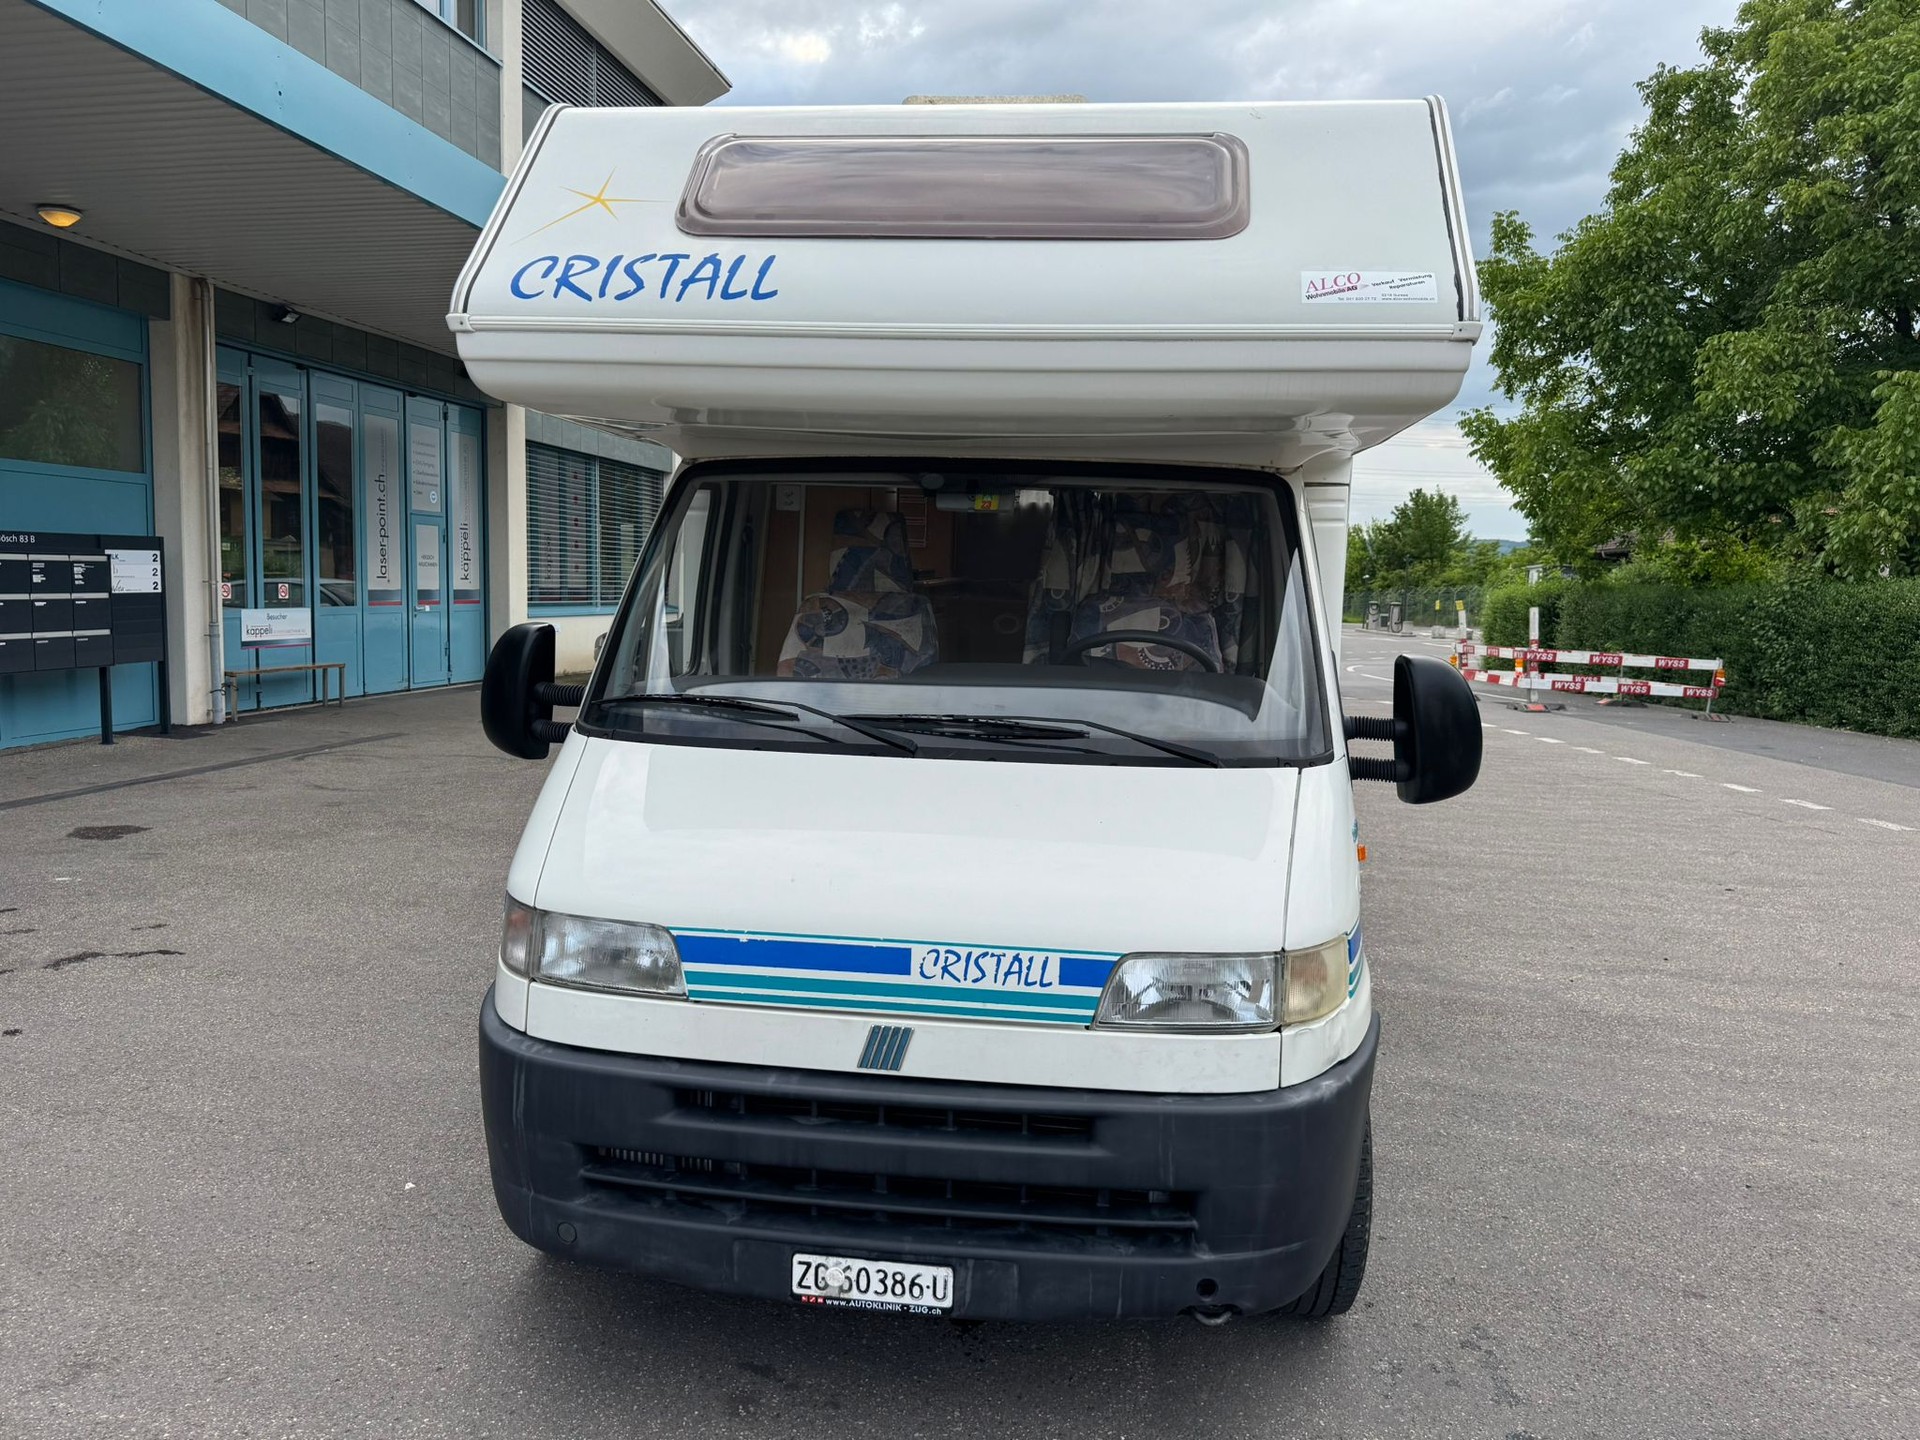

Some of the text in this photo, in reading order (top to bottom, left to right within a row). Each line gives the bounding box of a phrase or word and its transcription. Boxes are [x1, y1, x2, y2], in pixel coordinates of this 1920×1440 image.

[510, 253, 778, 302] CRISTALL
[1305, 272, 1361, 293] ALCO
[375, 474, 389, 579] laser-point.ch
[0, 534, 36, 543] ösch 83 B
[459, 522, 472, 581] kappeli
[152, 553, 159, 562] 2
[152, 567, 159, 577] 2
[152, 581, 159, 591] 2
[246, 624, 273, 638] kappeli
[1526, 652, 1554, 661] WYSS
[1592, 656, 1619, 665] WYSS
[1658, 659, 1685, 668] WYSS
[1554, 681, 1581, 690] WYSS
[1621, 684, 1648, 693] WYSS
[1686, 688, 1713, 697] WYSS
[919, 949, 1052, 987] CRISTALL
[826, 1299, 902, 1312] www.AUTOKLINIK
[909, 1305, 942, 1315] ZUG.ch
